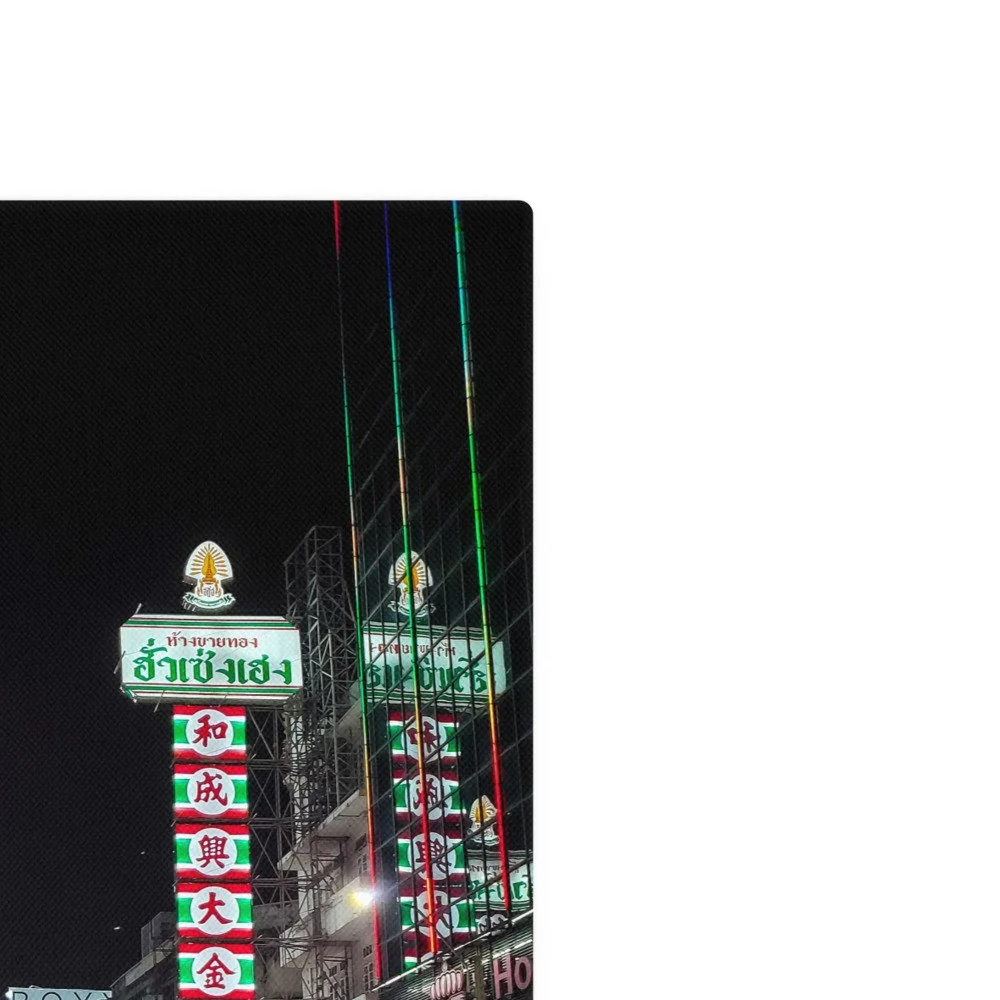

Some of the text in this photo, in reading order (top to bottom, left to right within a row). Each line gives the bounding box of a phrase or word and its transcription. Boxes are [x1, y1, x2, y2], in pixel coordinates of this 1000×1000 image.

[166, 631, 259, 649] ห้างขายทอง
[132, 637, 293, 685] ฮั่วเซ่งเฮง
